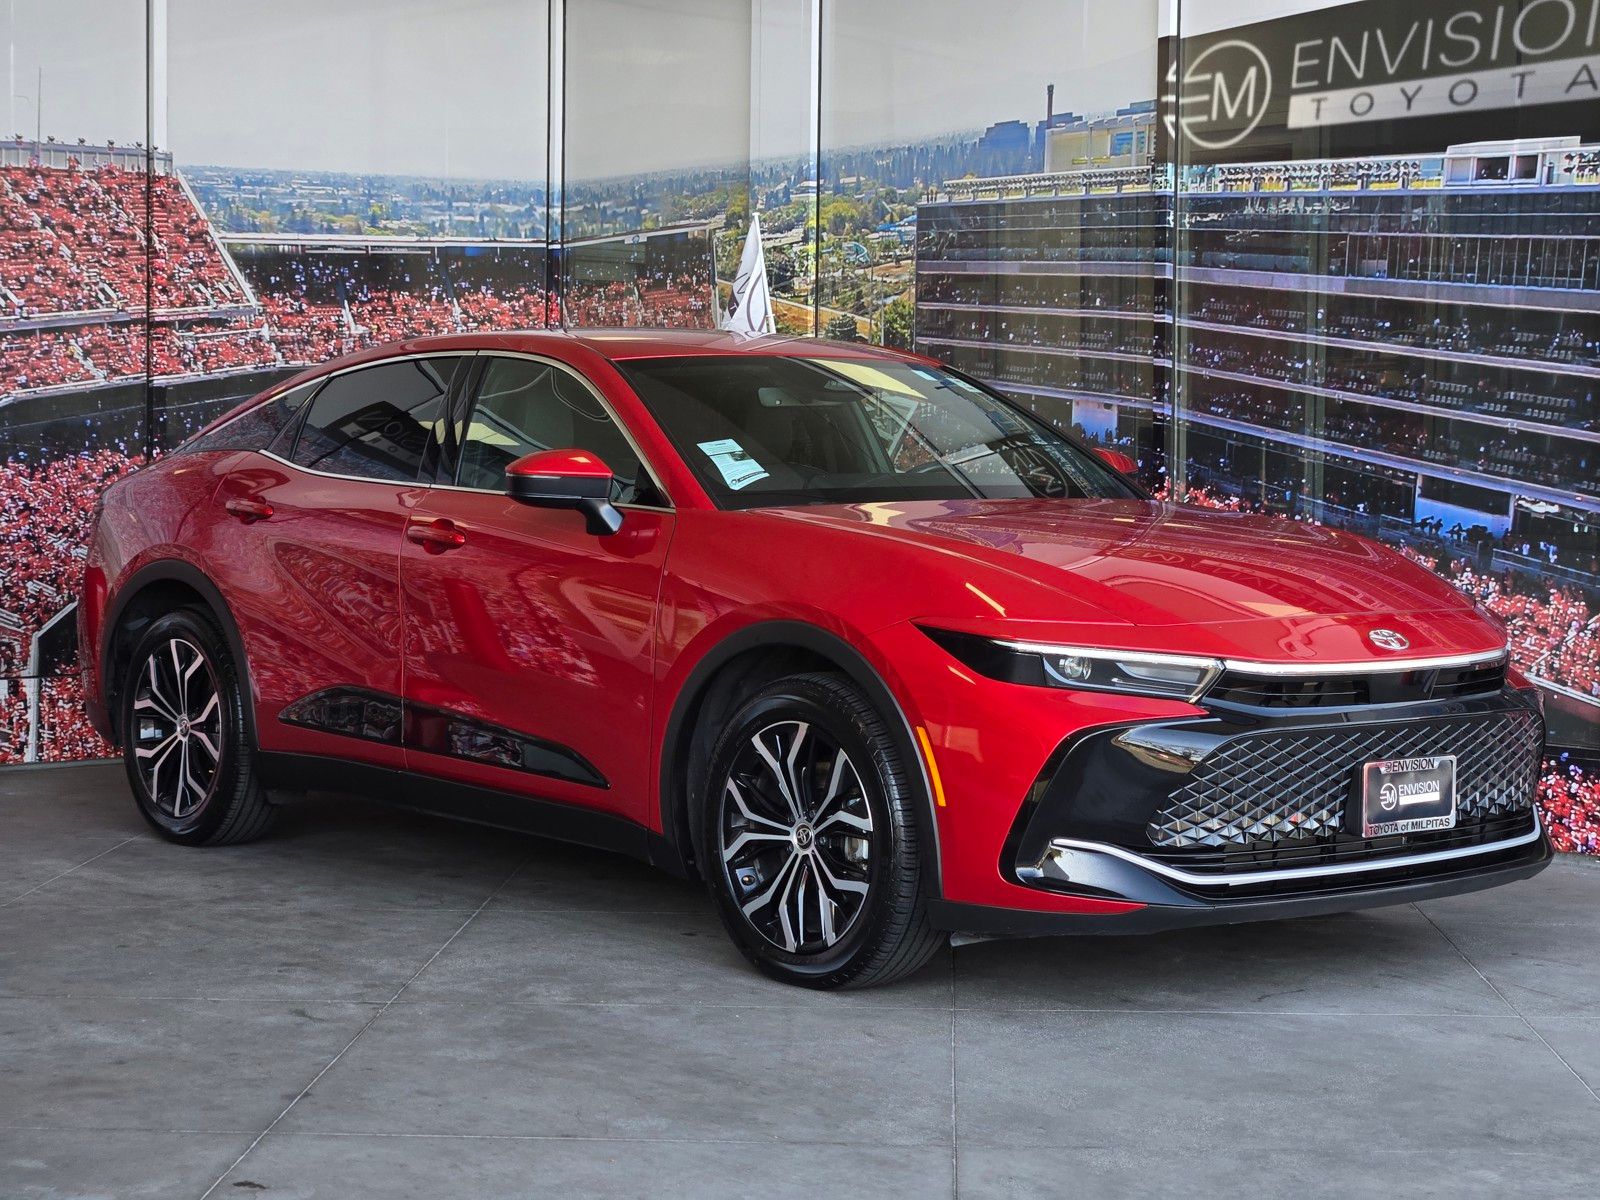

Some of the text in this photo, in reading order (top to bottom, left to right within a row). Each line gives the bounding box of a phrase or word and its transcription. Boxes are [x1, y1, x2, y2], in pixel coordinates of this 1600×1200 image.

[1311, 63, 1599, 121] TOYOTA
[1393, 758, 1435, 772] ENVISION
[1398, 780, 1440, 795] ENVISION
[1369, 818, 1450, 836] TOYOTA of MILPITAS
